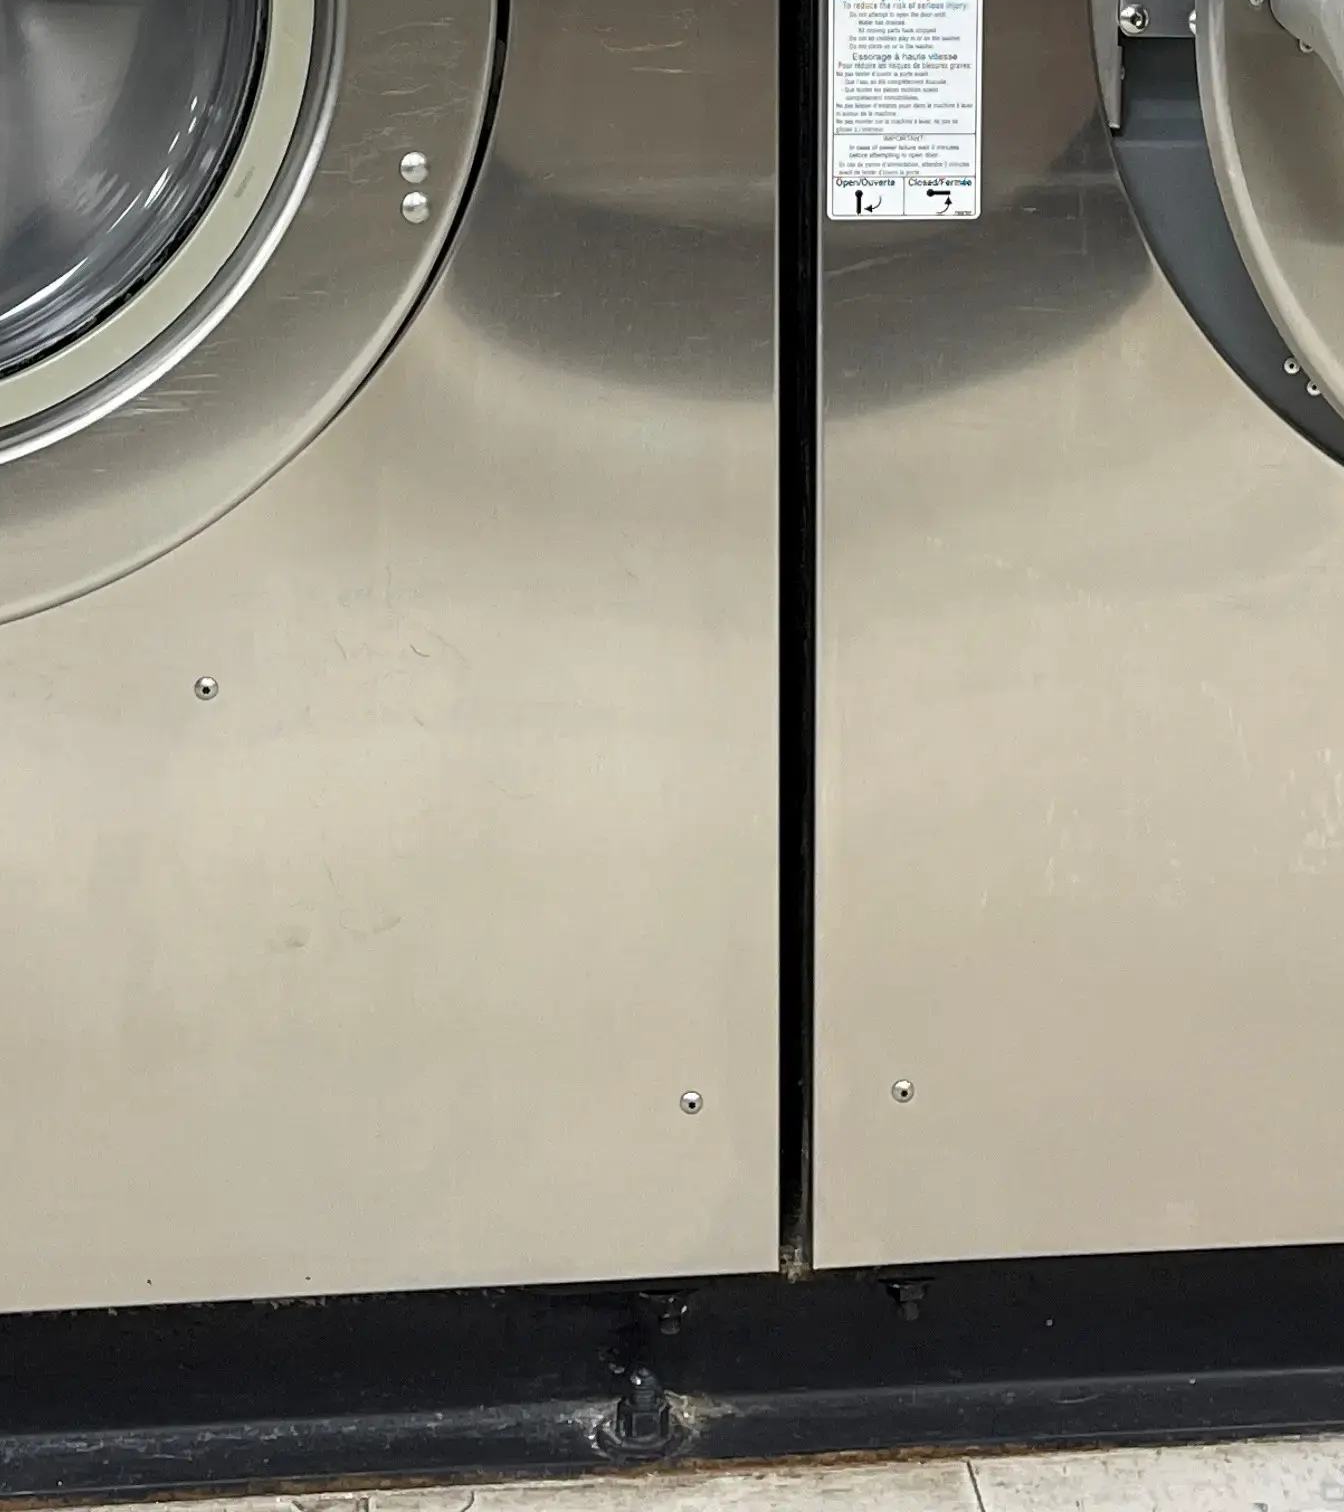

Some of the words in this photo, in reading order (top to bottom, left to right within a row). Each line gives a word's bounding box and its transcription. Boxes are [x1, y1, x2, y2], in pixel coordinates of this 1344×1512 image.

[853, 52, 892, 63] Essorage
[836, 178, 895, 188] Open/Ouverte
[908, 178, 972, 188] Closed/Fermée
